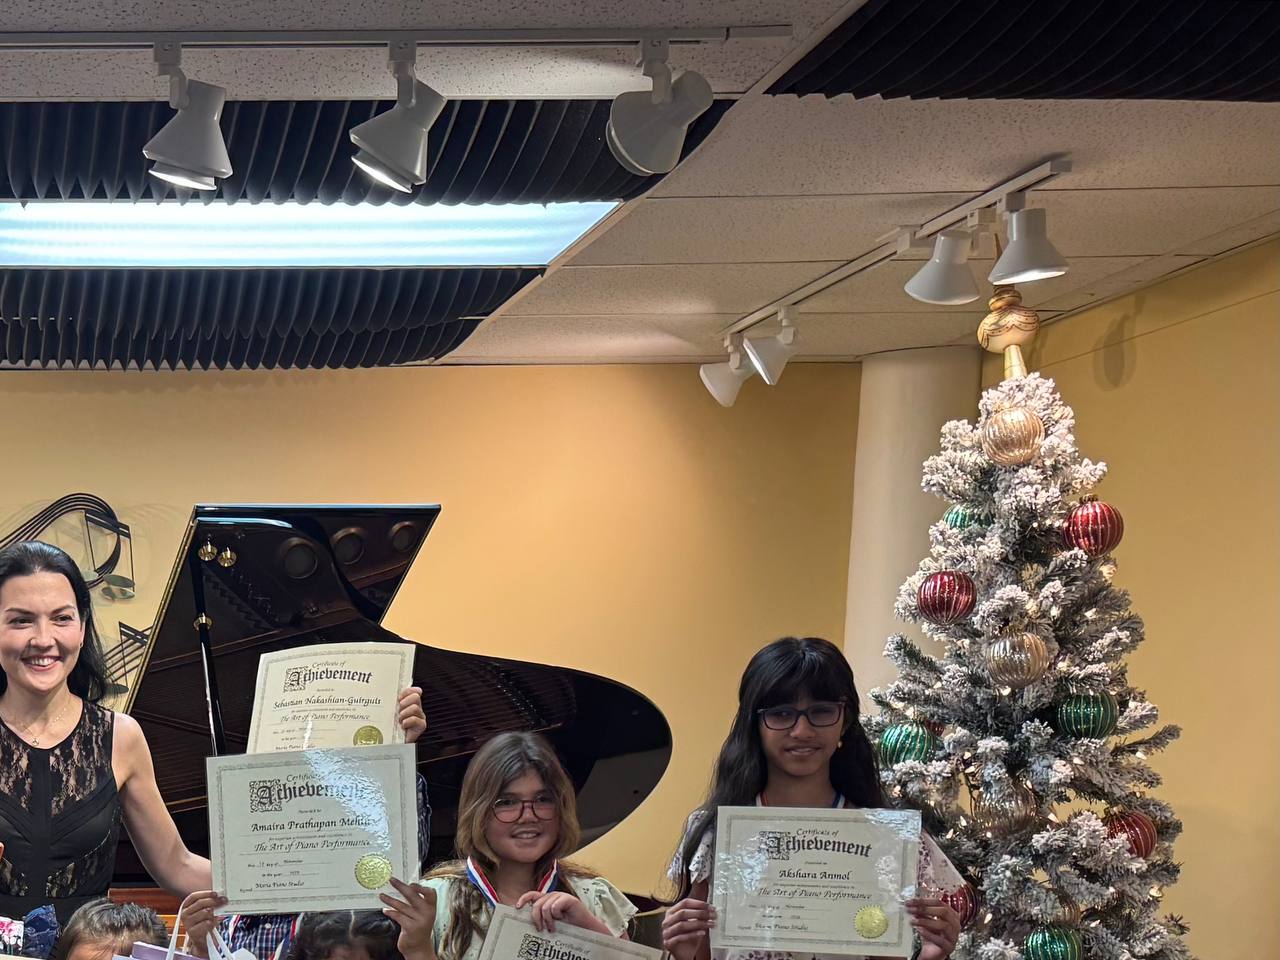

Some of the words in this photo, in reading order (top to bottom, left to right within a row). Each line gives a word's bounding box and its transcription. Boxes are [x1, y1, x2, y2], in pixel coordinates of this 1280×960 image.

[289, 667, 372, 686] Achievement
[274, 699, 303, 709] Sebastian
[250, 822, 285, 832] Amaira
[287, 817, 337, 832] Prathapan
[796, 828, 830, 836] Certificate
[254, 842, 267, 852] The
[269, 842, 283, 851] Art
[284, 840, 296, 853] of
[295, 841, 319, 850] Piano
[321, 839, 371, 851] Performance
[766, 835, 872, 858] Achievement
[779, 868, 817, 879] Akshara
[819, 870, 852, 880] Anmol
[758, 887, 771, 896] The
[772, 888, 787, 897] Art
[788, 889, 797, 899] of
[798, 889, 822, 897] Piano
[823, 890, 872, 902] Performance
